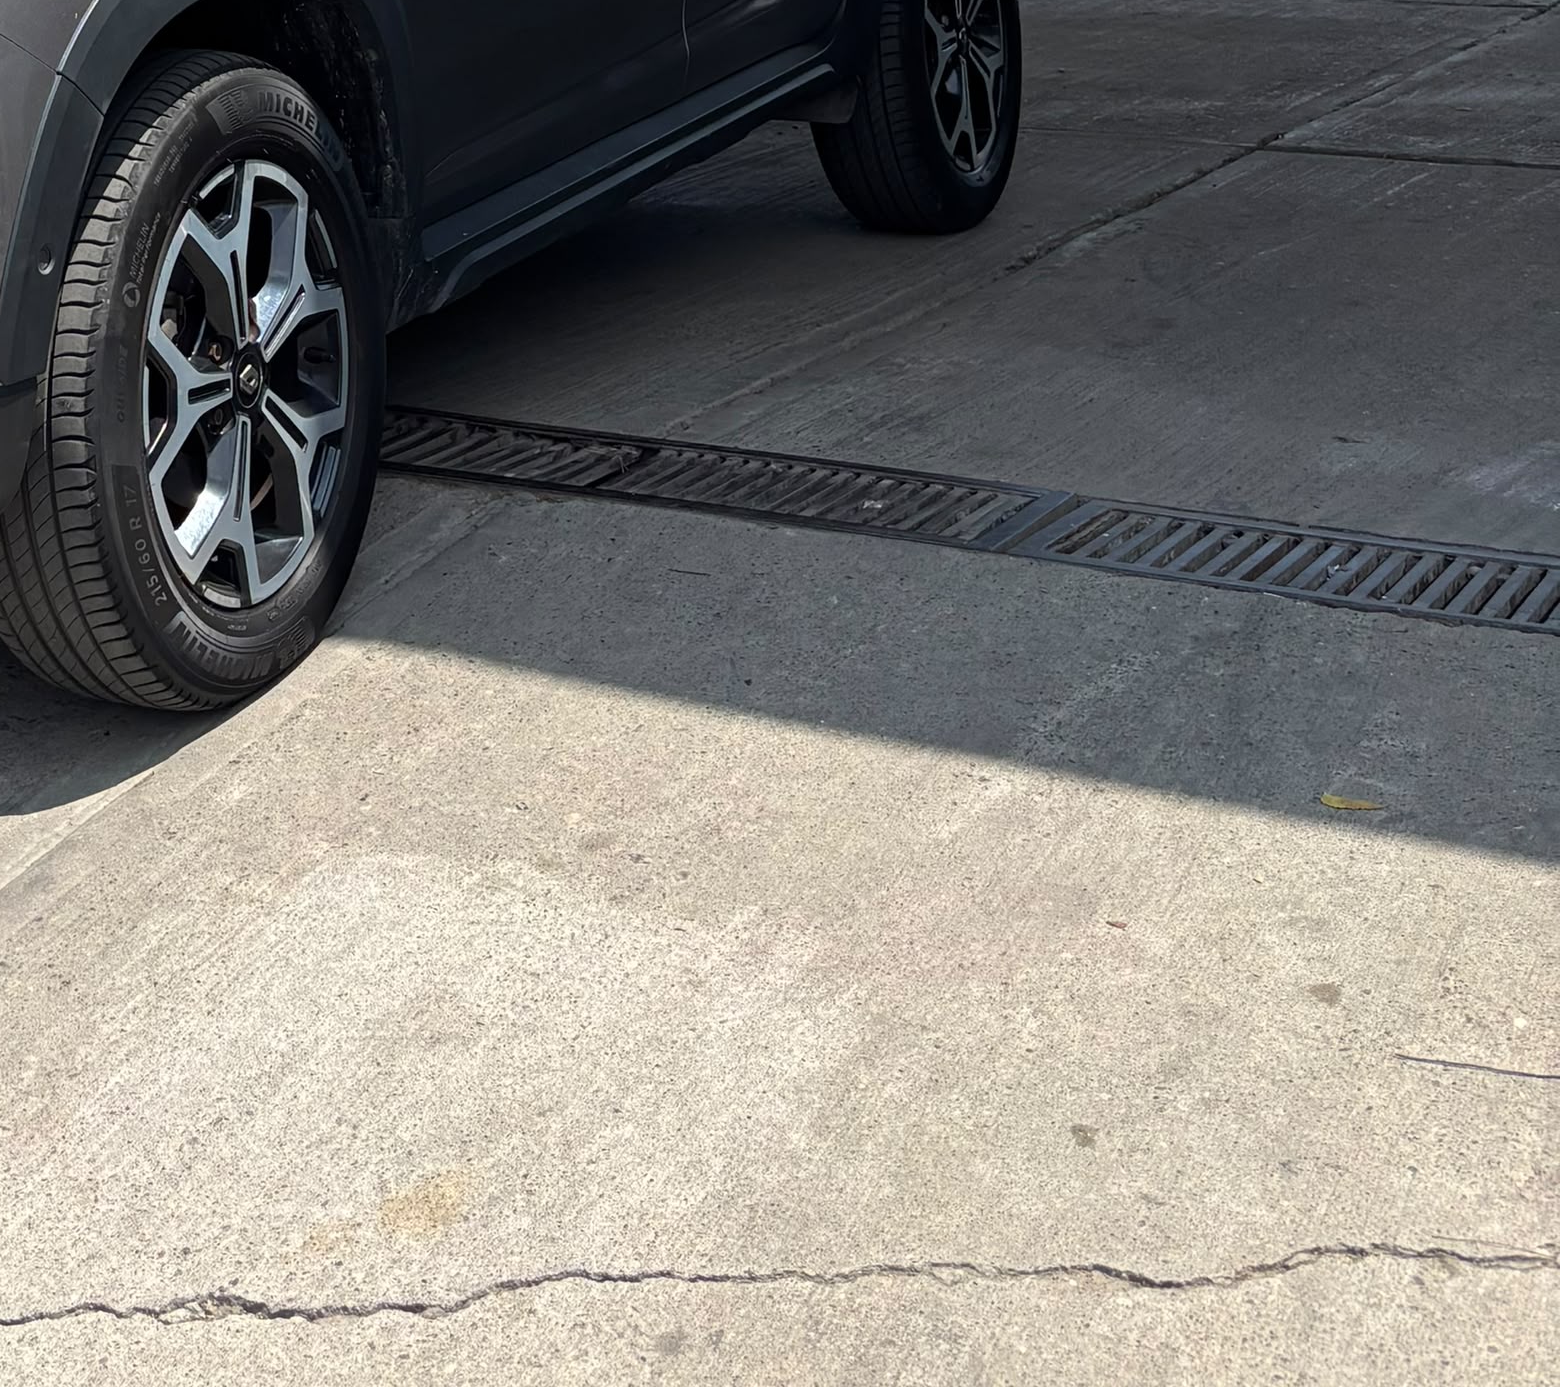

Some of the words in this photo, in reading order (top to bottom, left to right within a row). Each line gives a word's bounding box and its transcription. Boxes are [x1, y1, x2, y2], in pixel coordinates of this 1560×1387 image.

[129, 222, 151, 279] MICHELIN
[122, 483, 138, 507] 17
[128, 517, 143, 530] R
[134, 538, 168, 607] 215/60
